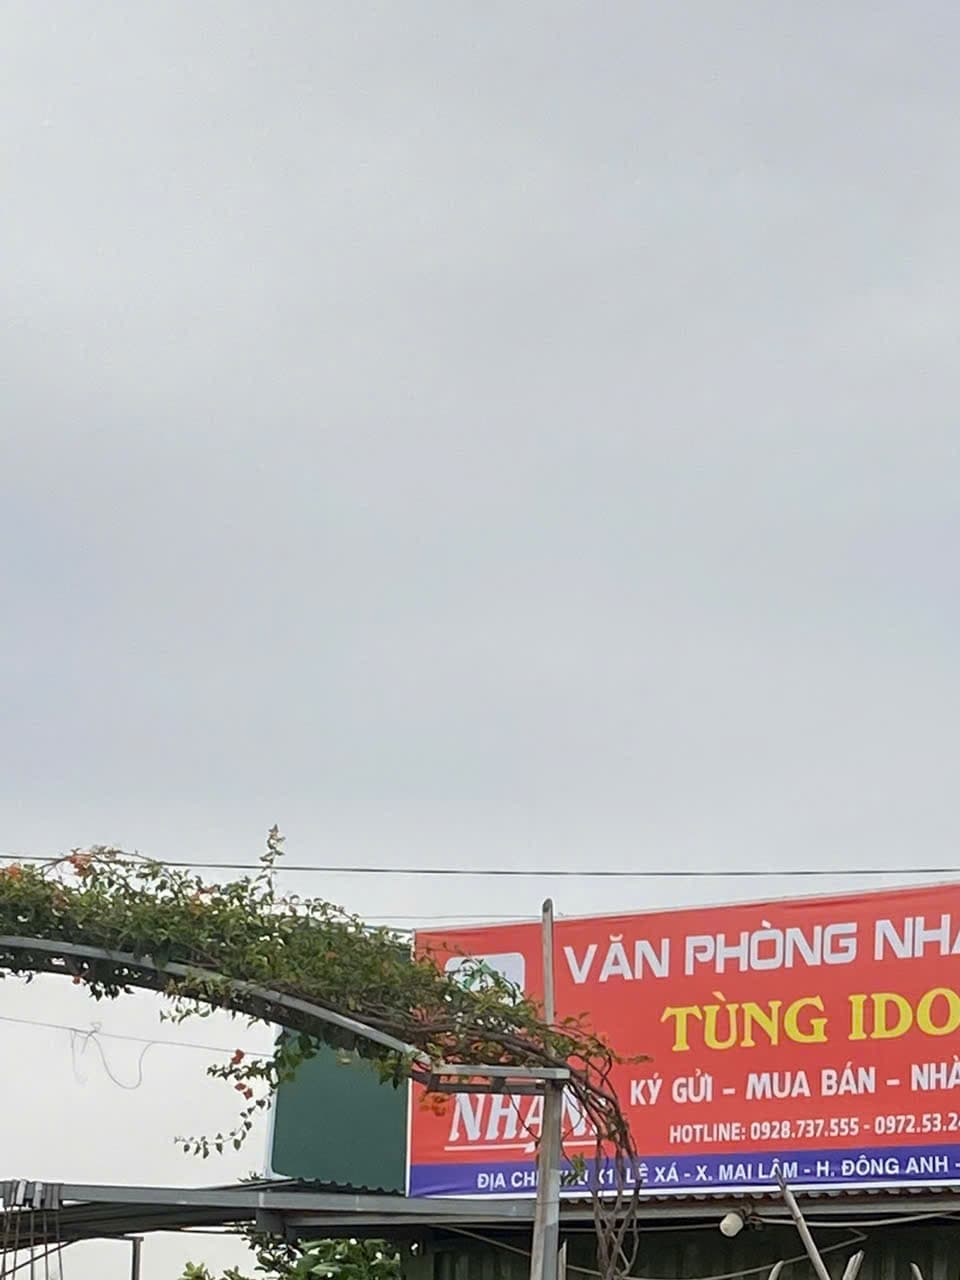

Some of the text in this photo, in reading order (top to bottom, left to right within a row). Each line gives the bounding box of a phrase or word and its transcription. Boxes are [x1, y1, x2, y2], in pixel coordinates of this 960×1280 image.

[563, 934, 670, 984] VĂN
[685, 920, 857, 976] PHÒNG
[660, 991, 828, 1052] TÙNG
[630, 1071, 662, 1106] KÝ
[672, 1068, 713, 1103] GỬI
[746, 1070, 811, 1101] MUA
[821, 1061, 876, 1097] BÁN
[670, 1122, 746, 1144] HOTLINE:
[751, 1117, 859, 1141] 0928.737.555
[477, 1173, 506, 1192] ĐỊA
[654, 1162, 679, 1183] XÁ
[695, 1165, 713, 1182] X.
[719, 1164, 752, 1182] MAI
[758, 1158, 798, 1179] LÂM
[816, 1161, 835, 1178] H.
[842, 1155, 899, 1177] ĐÔNG
[905, 1155, 948, 1174] ANH
